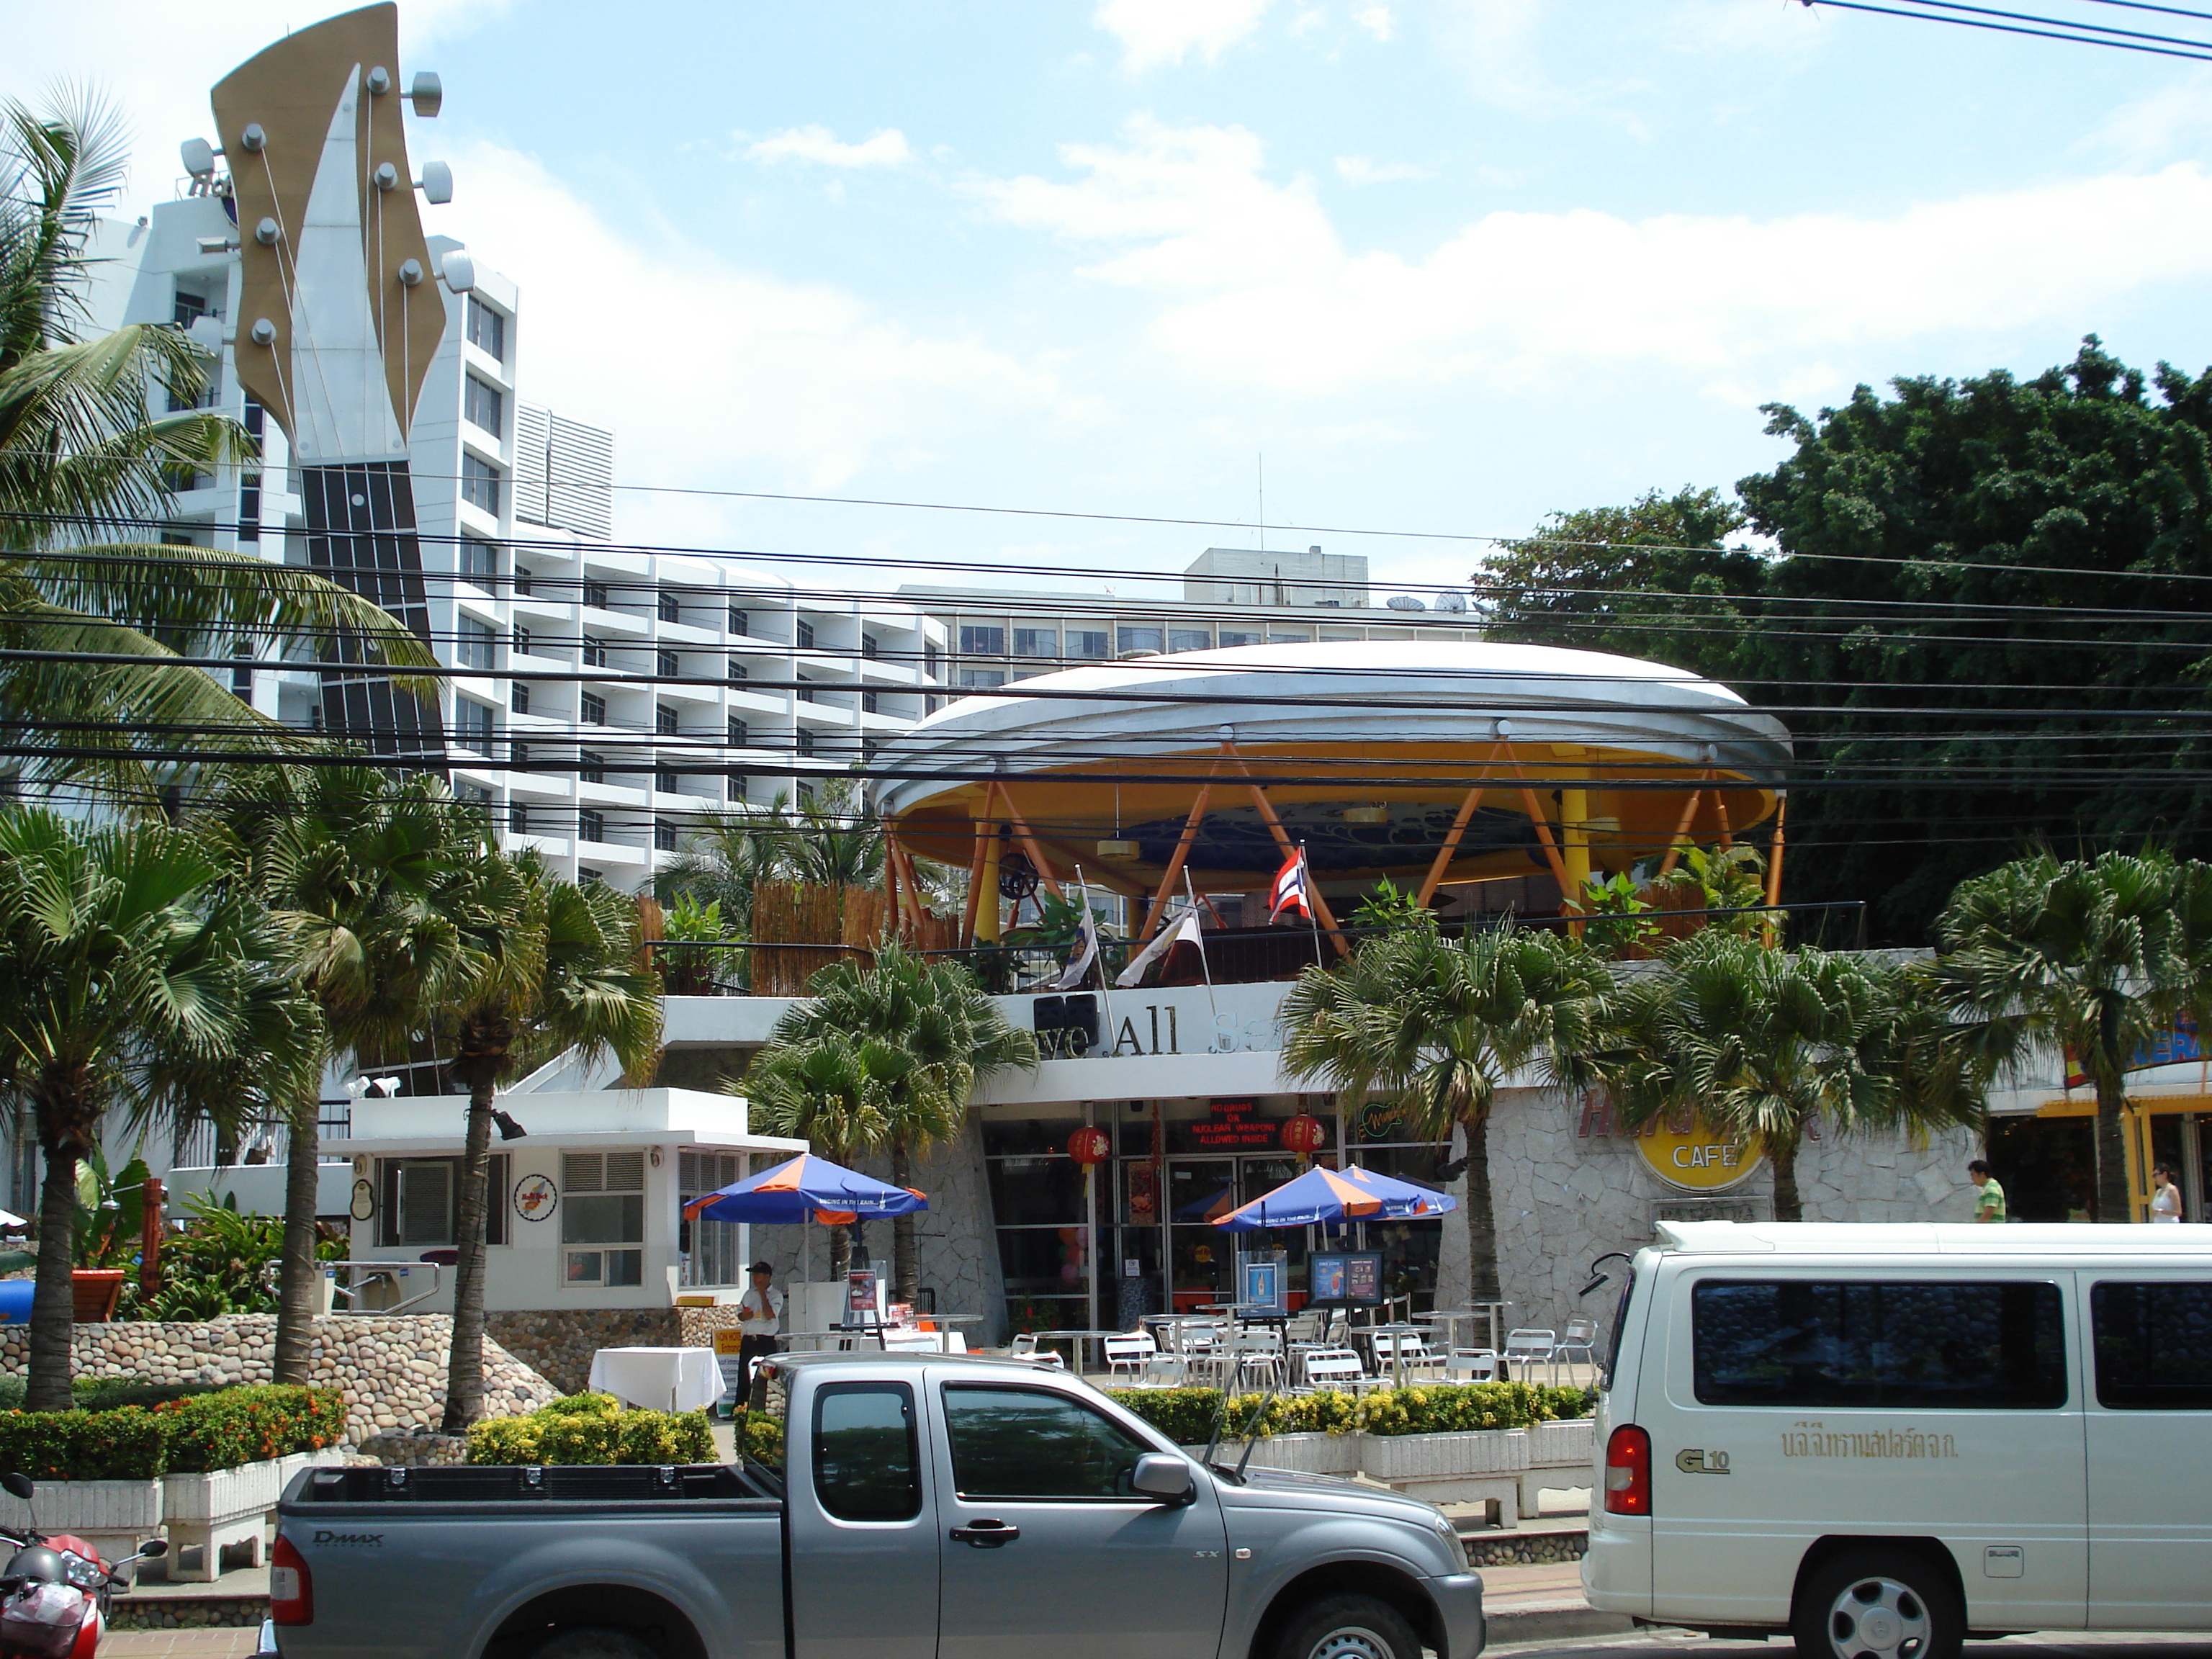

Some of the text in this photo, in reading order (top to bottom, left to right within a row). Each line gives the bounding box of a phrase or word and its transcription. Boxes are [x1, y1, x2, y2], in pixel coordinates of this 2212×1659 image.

[1113, 1005, 1182, 1056] All
[1225, 1102, 1252, 1112] DRUGS
[1227, 1114, 1239, 1123] OR
[1192, 1123, 1276, 1133] NUCLEAR WEAPONS
[1200, 1134, 1268, 1144] ALLOWED INSIDE
[1672, 1145, 1739, 1169] CAFE
[1676, 1449, 1730, 1475] GL 10
